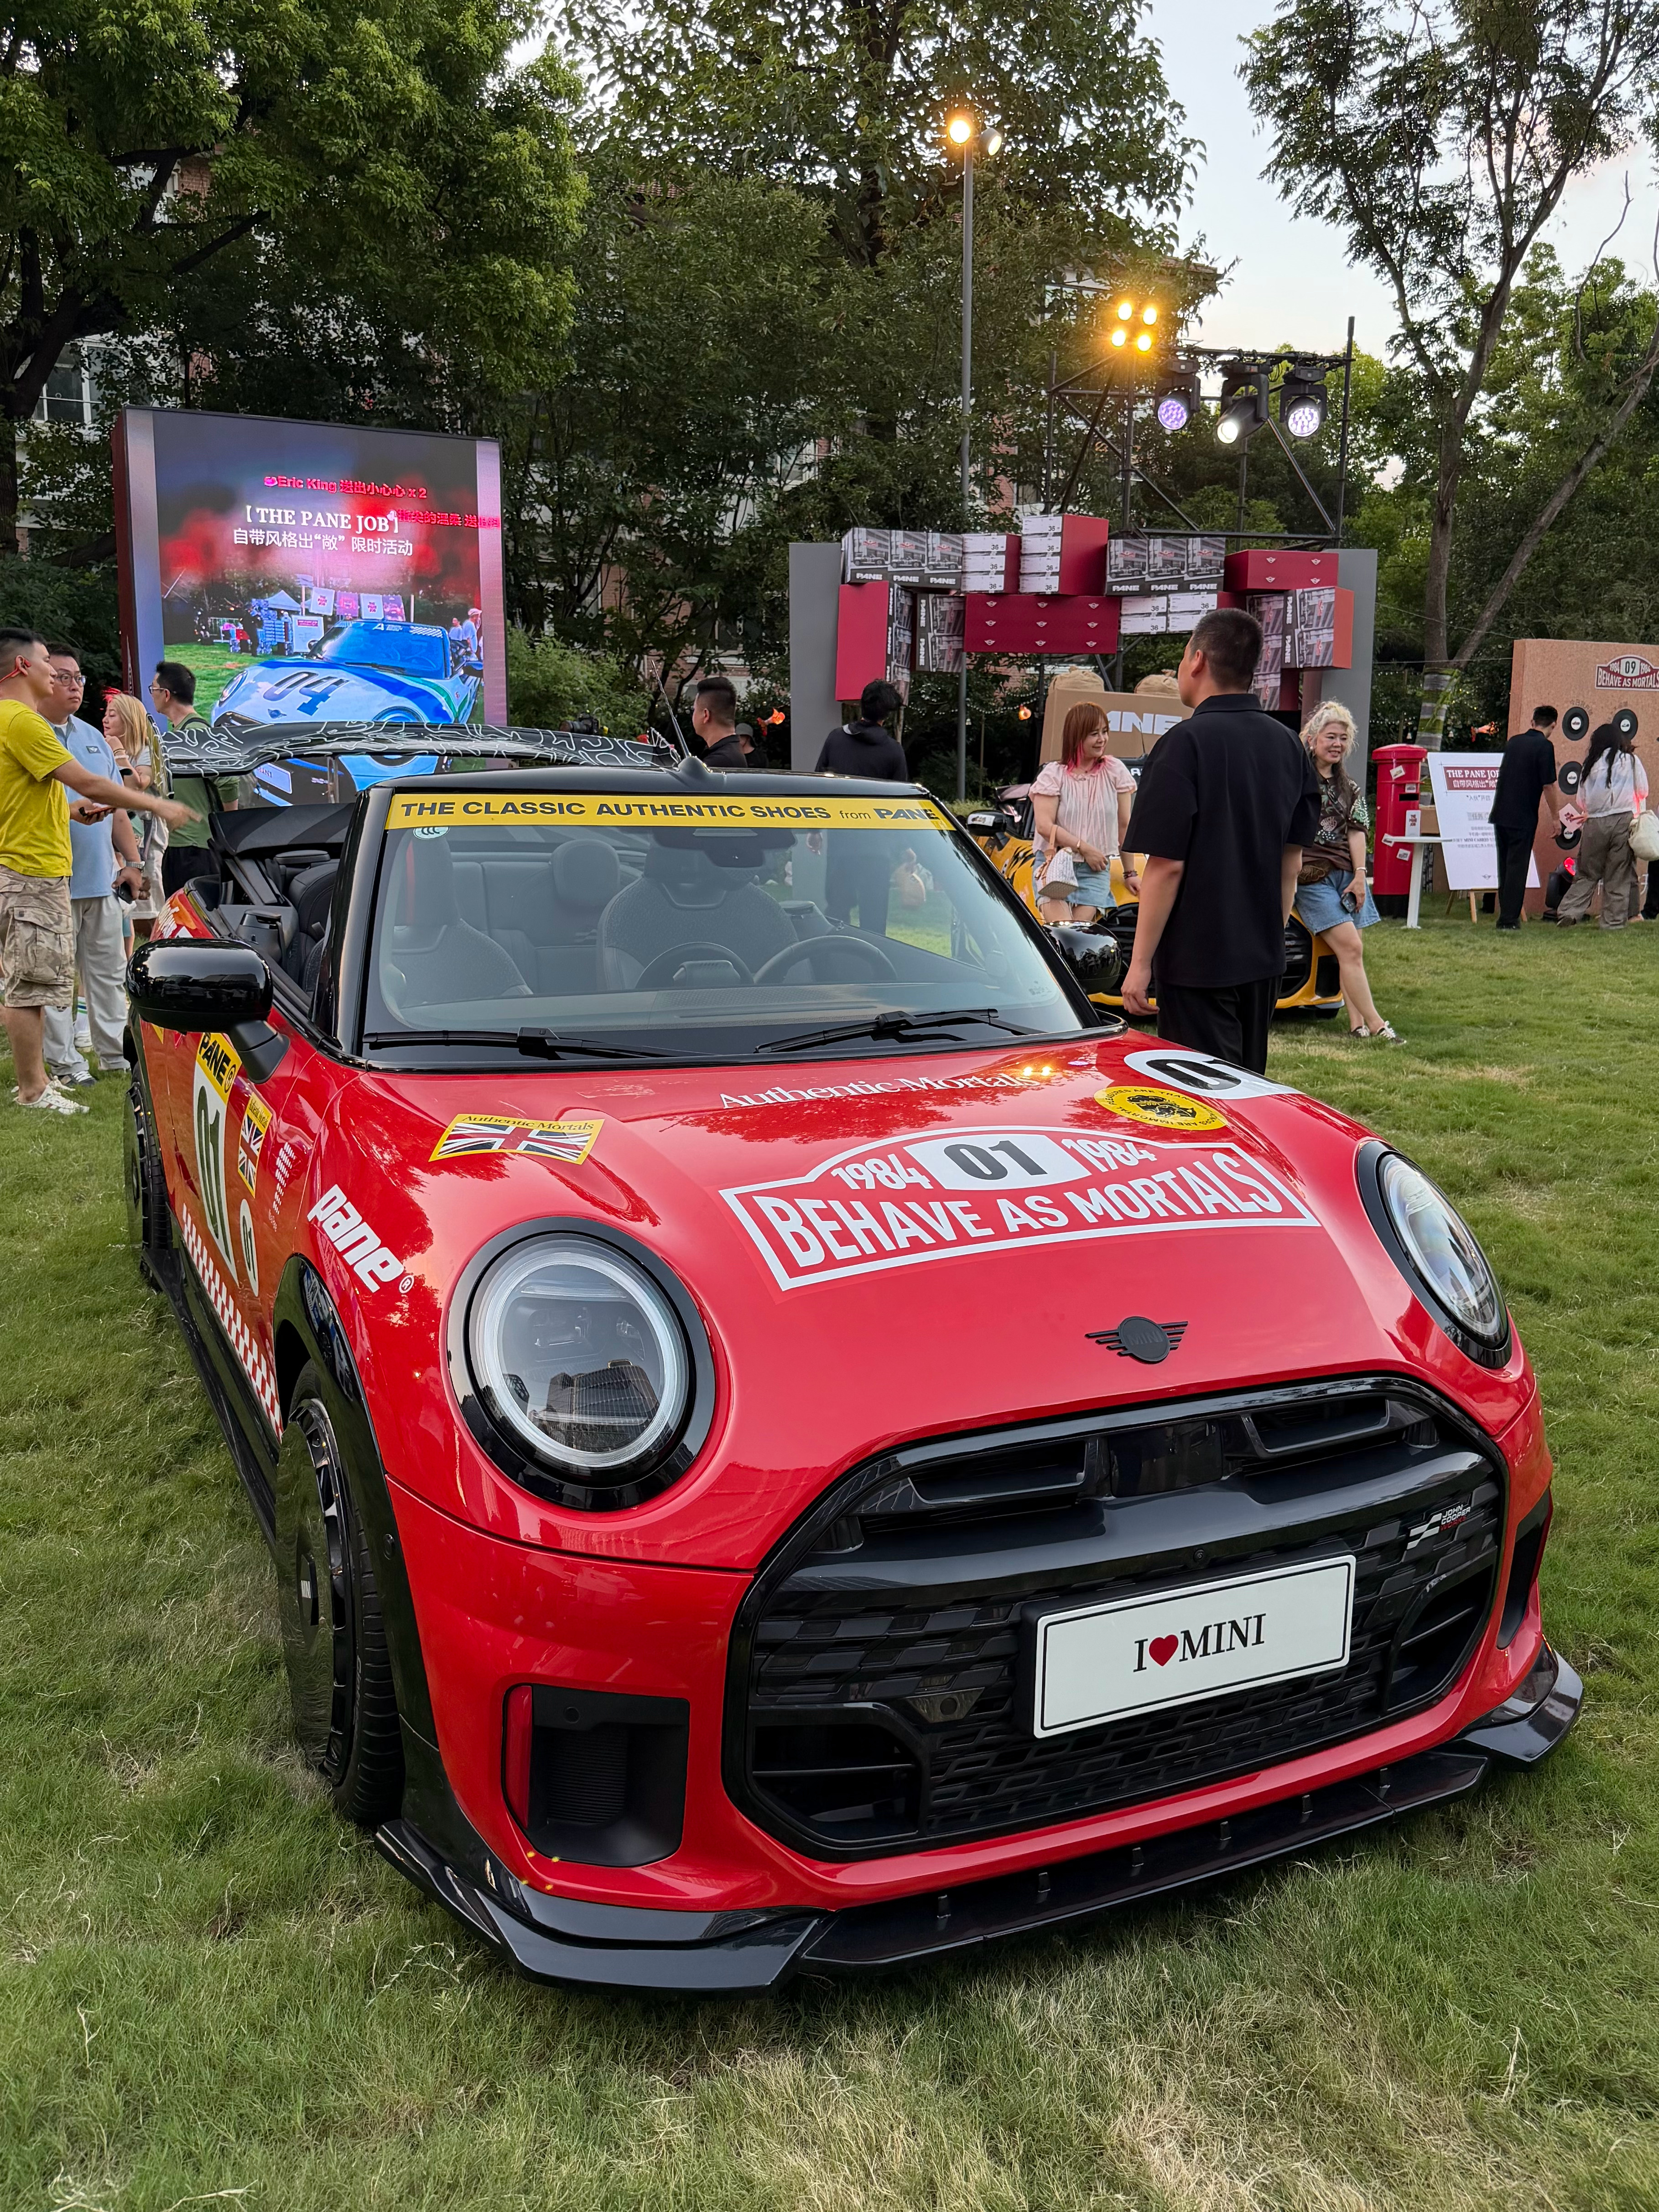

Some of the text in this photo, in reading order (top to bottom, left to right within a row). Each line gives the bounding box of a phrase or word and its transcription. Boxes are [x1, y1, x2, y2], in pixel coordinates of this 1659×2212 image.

[277, 476, 304, 488] Eric
[307, 478, 337, 493] King
[339, 479, 406, 498] 送出小心心
[418, 487, 427, 498] 2
[302, 511, 352, 530] PANE
[856, 572, 883, 581] PANE
[893, 575, 920, 583] PANE
[1609, 661, 1620, 674] 1984
[1625, 660, 1636, 674] 09
[1597, 667, 1622, 687] BEHAVE
[1623, 677, 1631, 687] AS
[263, 670, 349, 717] 04
[1446, 769, 1463, 778] THE
[1464, 769, 1486, 778] PANE
[401, 801, 940, 820] THE CLASSIC AUTHENTIC SHOES from PANE
[719, 1073, 1041, 1109] Authentic Mortals
[462, 1115, 594, 1131] Authentic Mortals
[830, 1138, 1157, 1190] 1984 01 1984
[752, 1152, 1283, 1267] BEHAVE AS MORTALS
[1441, 1506, 1472, 1525] COOPER
[1442, 1504, 1463, 1518] JOHN
[1440, 1516, 1467, 1532] WORKS
[1133, 1613, 1267, 1673] I MINI
